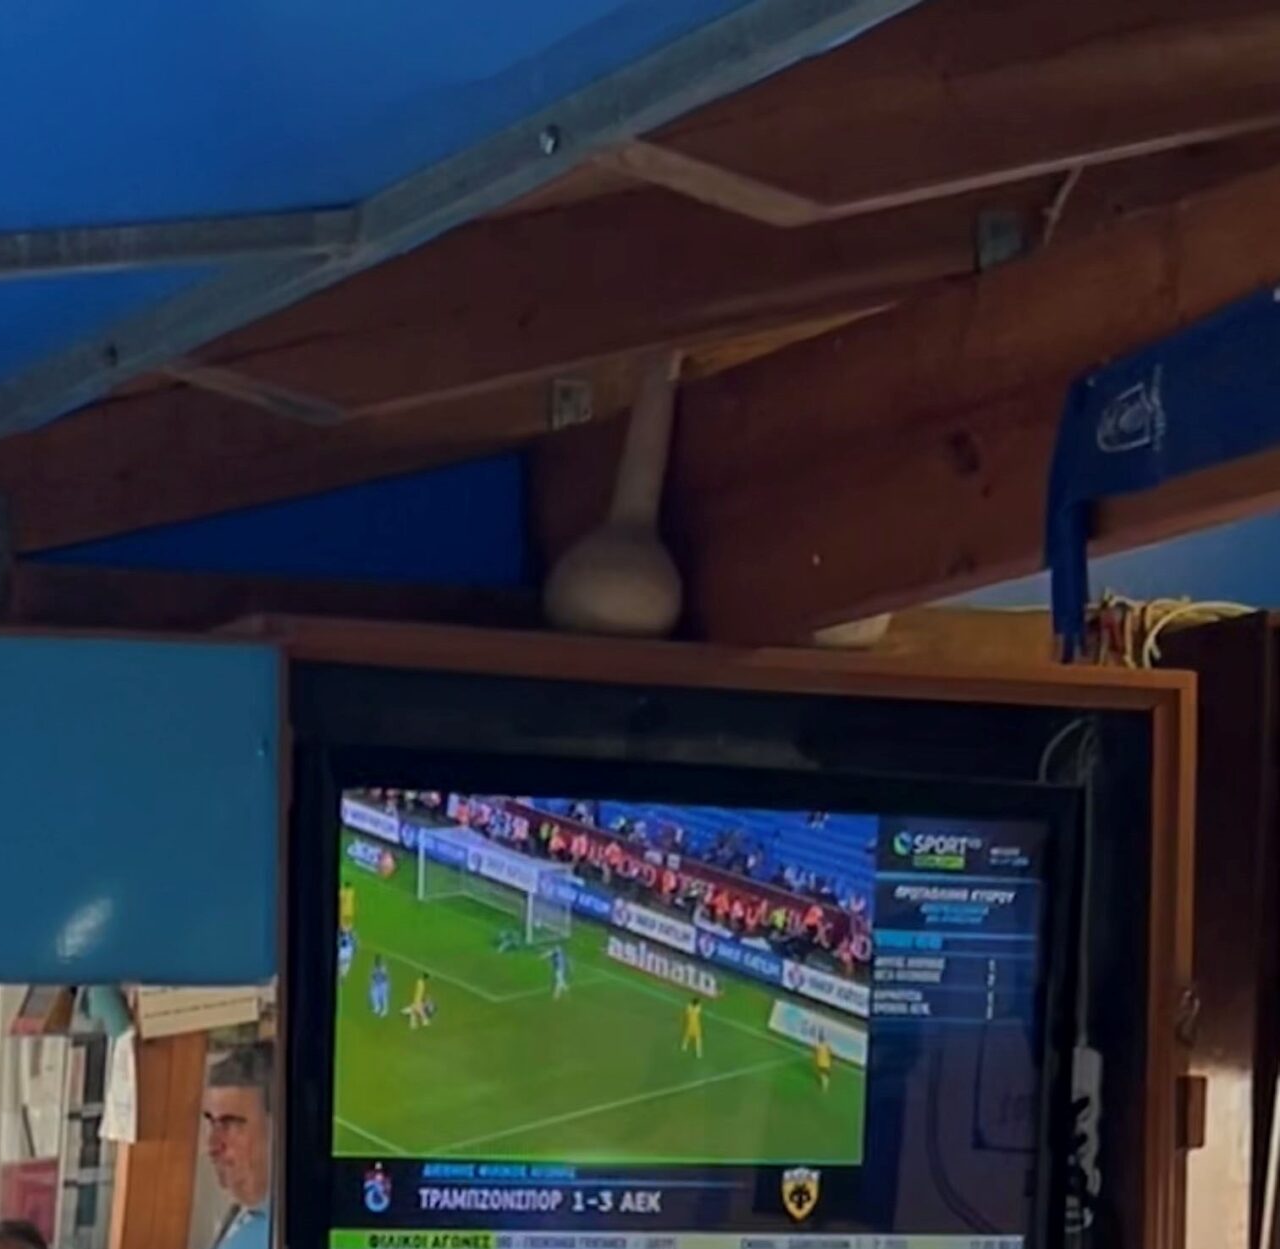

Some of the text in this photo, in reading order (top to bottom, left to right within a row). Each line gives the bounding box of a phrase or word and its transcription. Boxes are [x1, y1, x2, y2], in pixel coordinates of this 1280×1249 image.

[418, 1188, 662, 1213] ΤΡΑΜΠΖΟΝΣΠΟΡ 1-3 ΑΕΚ
